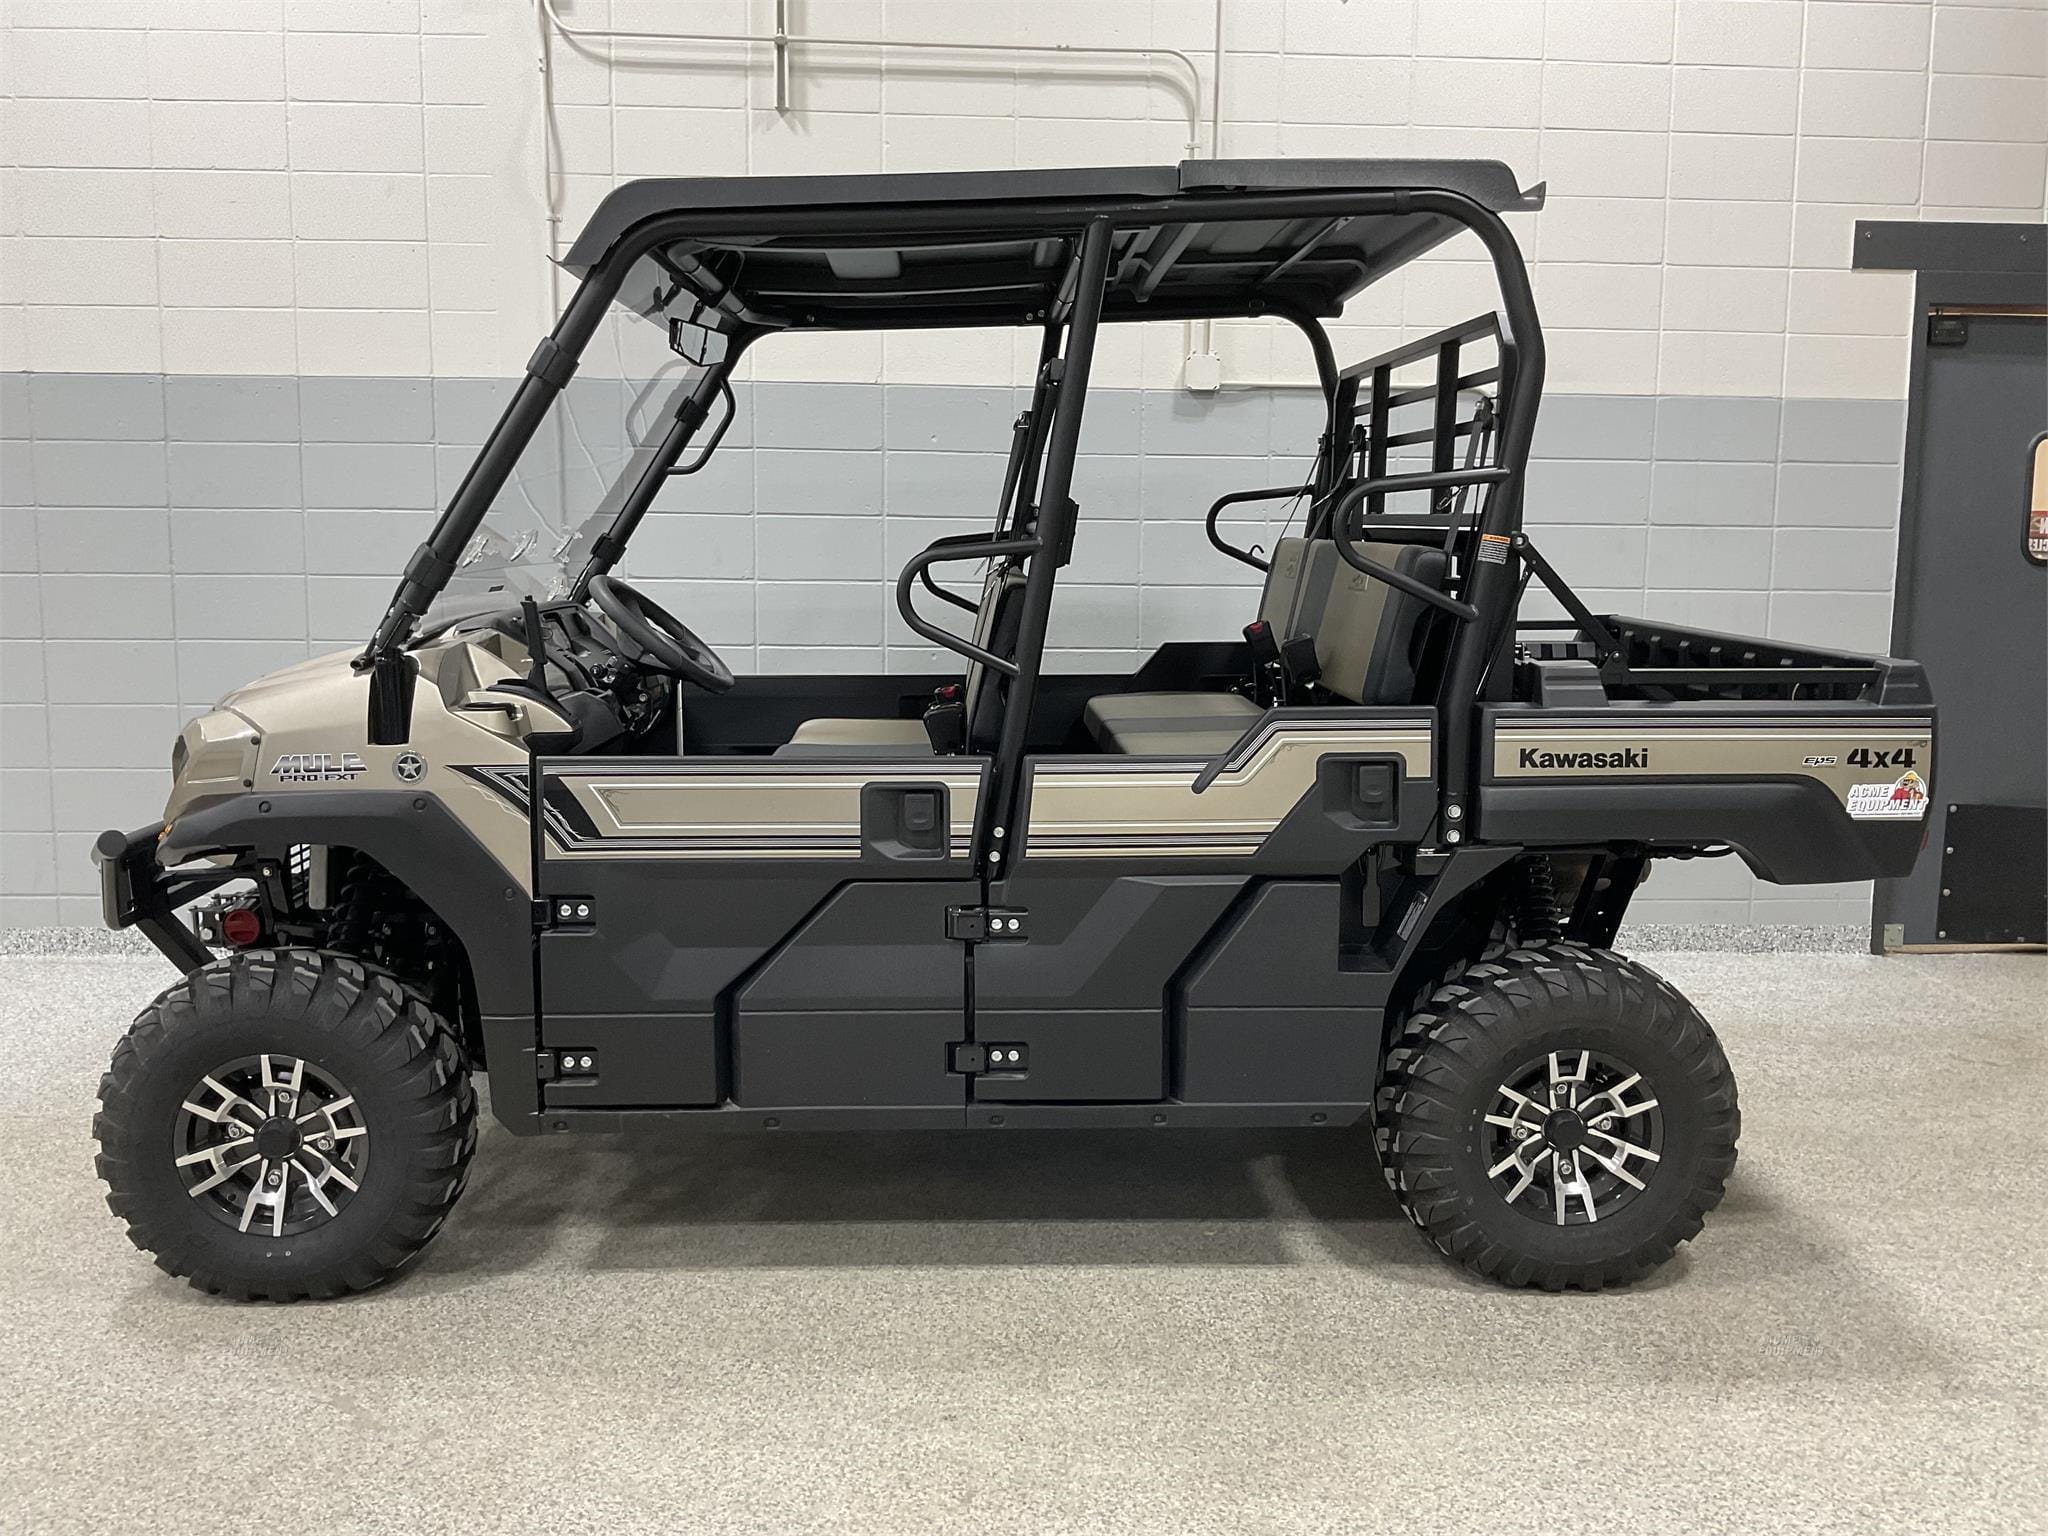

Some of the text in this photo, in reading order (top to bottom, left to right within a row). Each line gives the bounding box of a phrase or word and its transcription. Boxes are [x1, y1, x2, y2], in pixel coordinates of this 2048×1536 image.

[270, 753, 368, 774] MULE
[1519, 748, 1648, 768] Kawasaki
[1850, 785, 1889, 798] ACME
[1848, 800, 1928, 812] EQUIPMENT
